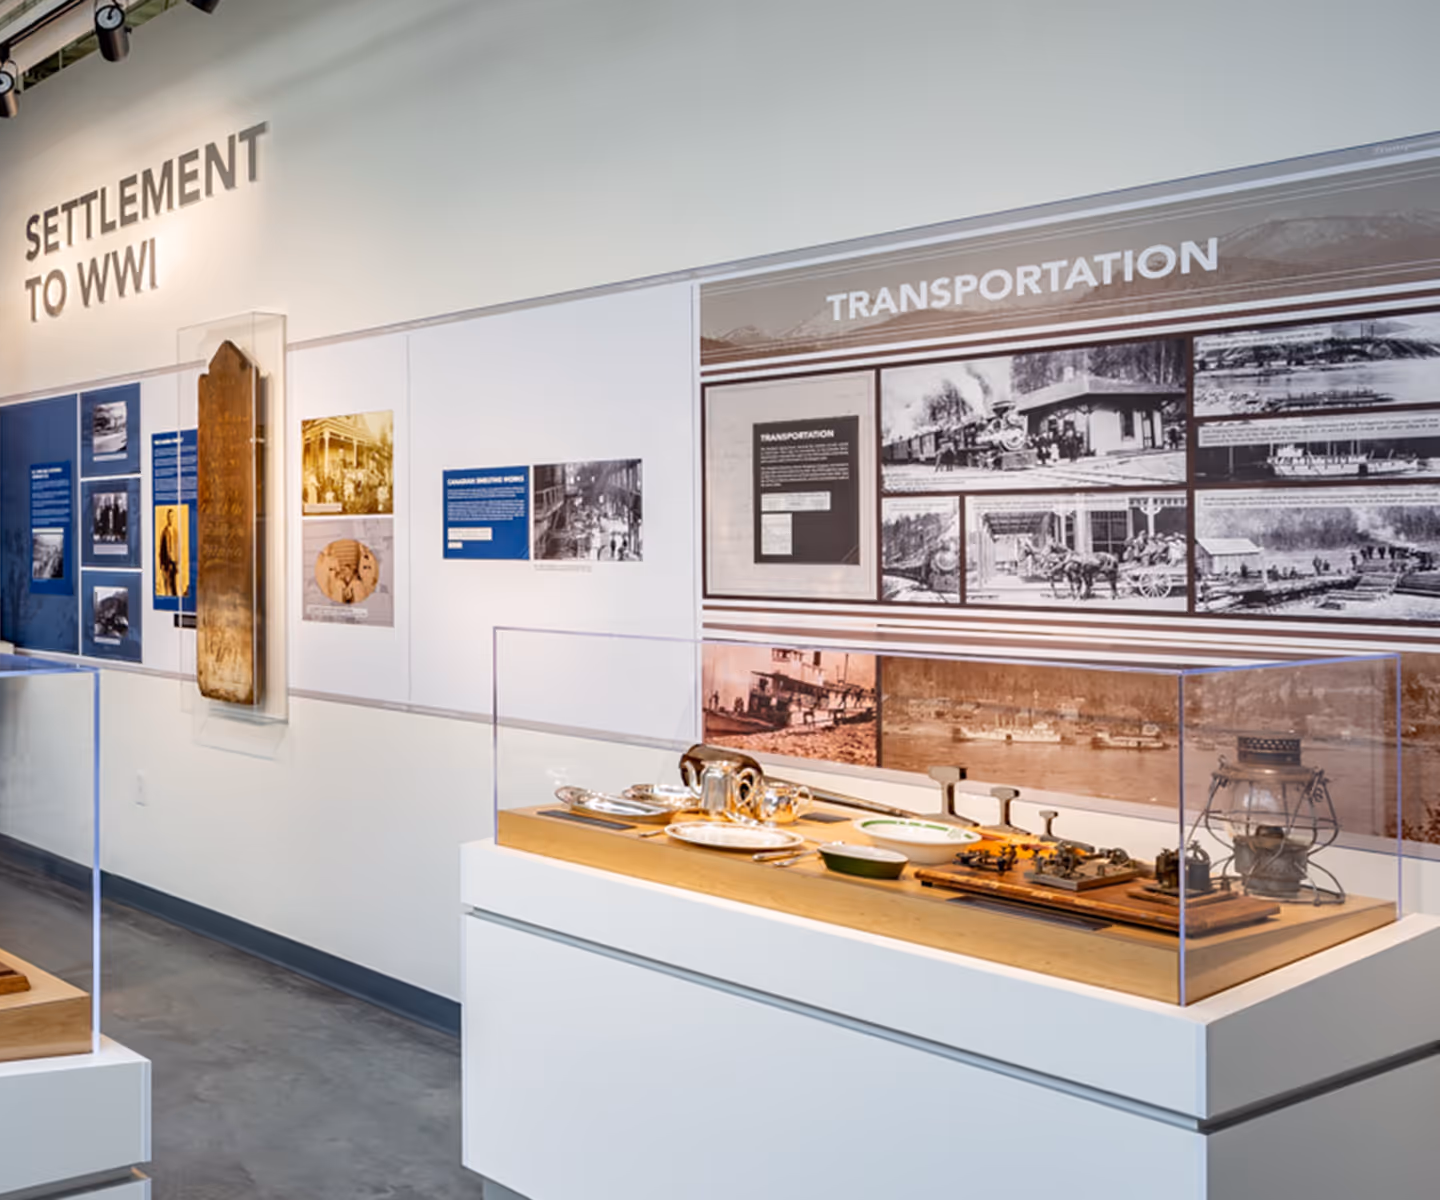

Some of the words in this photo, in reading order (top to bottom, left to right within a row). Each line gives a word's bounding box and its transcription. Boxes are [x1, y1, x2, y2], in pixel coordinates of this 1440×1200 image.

[26, 121, 269, 262] SETTLEMENT
[25, 268, 68, 323] TO
[77, 236, 158, 308] WWI
[826, 237, 1218, 321] TRANSPORTATION
[760, 429, 835, 441] TRANSPORTATION
[504, 475, 524, 483] WORKS
